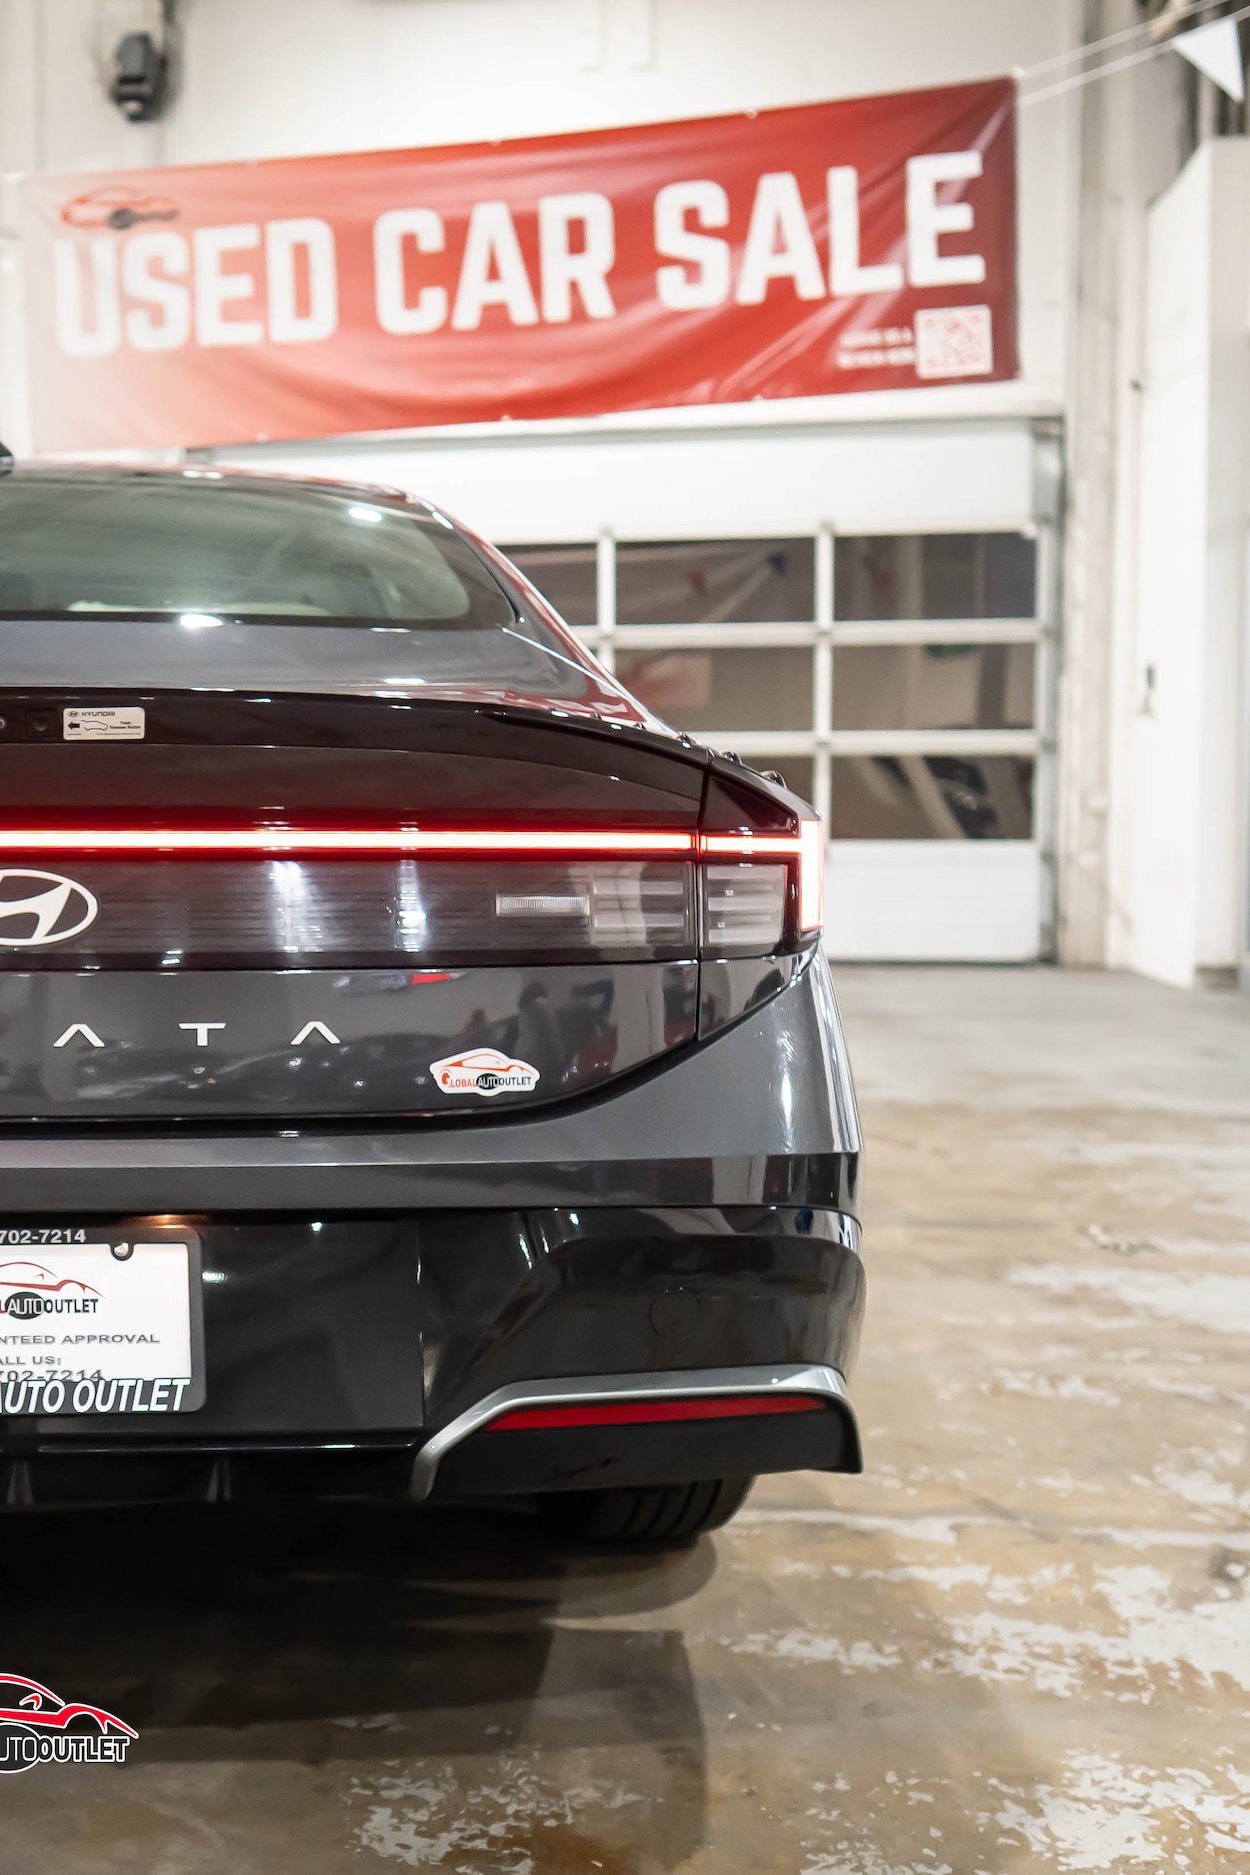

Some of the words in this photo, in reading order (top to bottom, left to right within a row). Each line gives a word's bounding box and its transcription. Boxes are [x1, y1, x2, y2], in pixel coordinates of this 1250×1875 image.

[53, 217, 338, 358] USED
[374, 193, 617, 336] CAR
[654, 150, 986, 311] SALE
[61, 1333, 161, 1345] APPROVAL
[32, 1356, 62, 1366] US:
[72, 1378, 191, 1413] OUTLET
